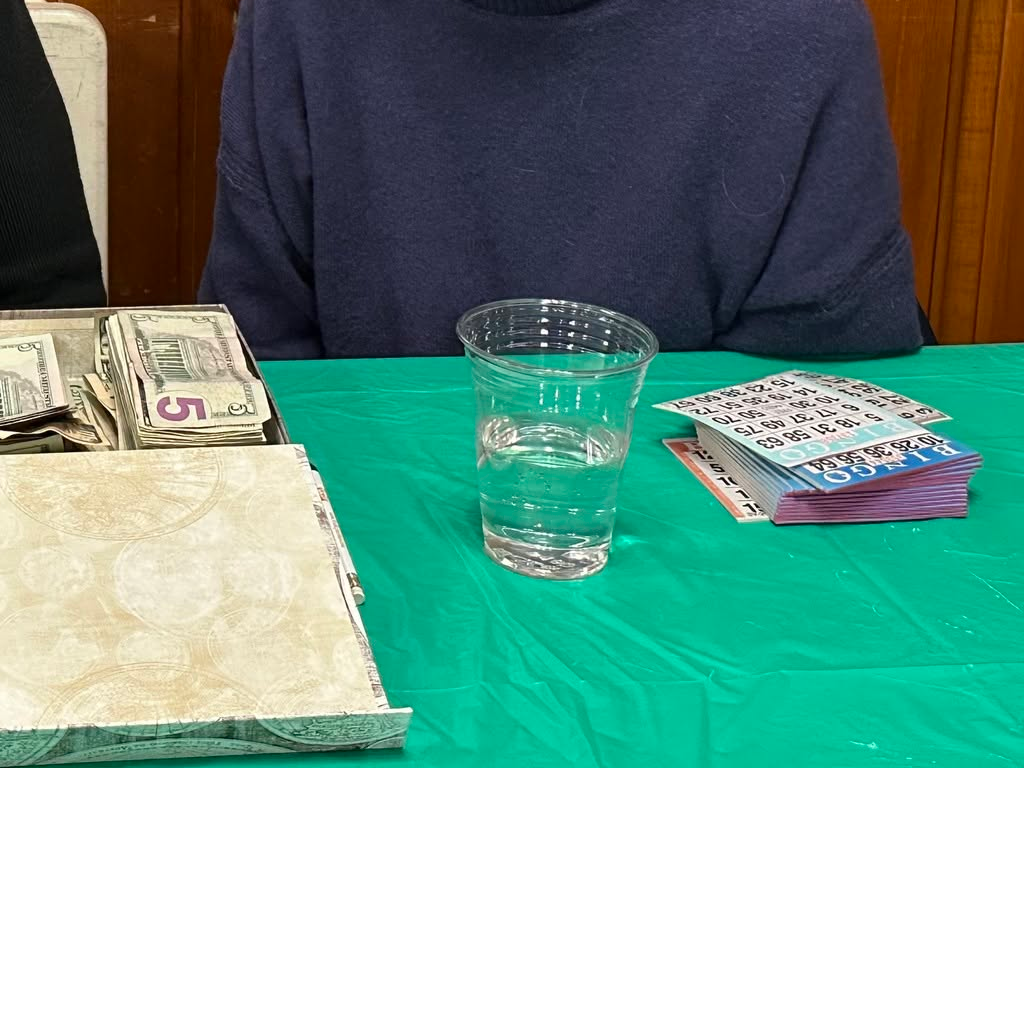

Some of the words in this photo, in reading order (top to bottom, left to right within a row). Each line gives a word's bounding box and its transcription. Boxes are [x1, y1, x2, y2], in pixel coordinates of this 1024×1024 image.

[771, 379, 795, 387] 15
[792, 387, 817, 396] 14
[742, 397, 769, 405] 35
[768, 393, 792, 401] 19
[815, 395, 839, 404] 10
[156, 396, 207, 422] 5
[718, 401, 743, 410] 51
[789, 400, 816, 409] 30
[738, 409, 765, 419] 50
[816, 409, 837, 417] 17
[865, 413, 883, 421] 5
[712, 415, 741, 425] 70
[789, 414, 814, 423] 37
[835, 418, 860, 428] 18
[760, 419, 786, 429] 49
[810, 423, 836, 435] 31
[734, 425, 762, 436] 75
[783, 429, 811, 441] 58
[756, 437, 784, 449] 63
[890, 439, 919, 452] 26
[919, 435, 944, 446] 10
[863, 446, 892, 458] 36
[837, 452, 863, 464] 56
[809, 458, 837, 471] 64
[823, 443, 960, 484] BINGO
